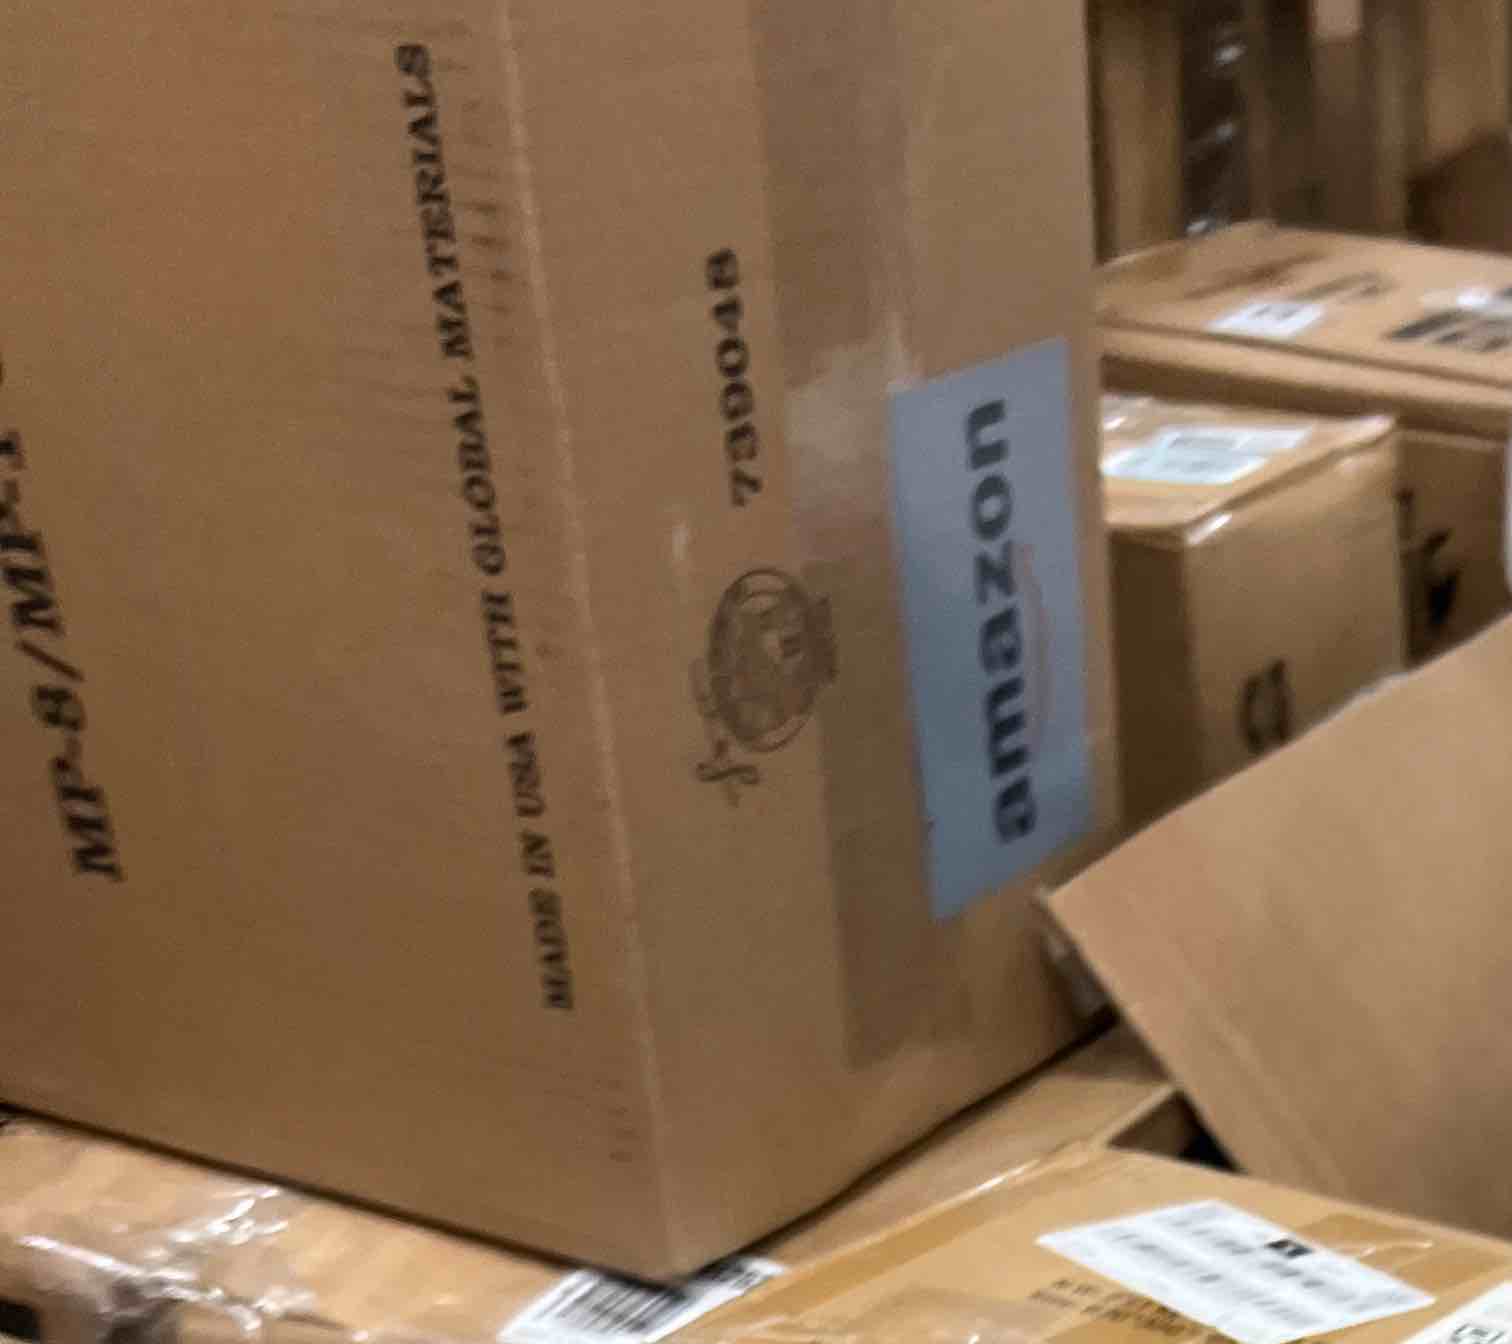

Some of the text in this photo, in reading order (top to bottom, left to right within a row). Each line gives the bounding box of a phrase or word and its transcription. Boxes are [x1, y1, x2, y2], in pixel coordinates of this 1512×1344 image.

[396, 43, 575, 1010] MADE IN USA WITH GLOBAL MATERIALS
[965, 399, 1037, 844] amazon
